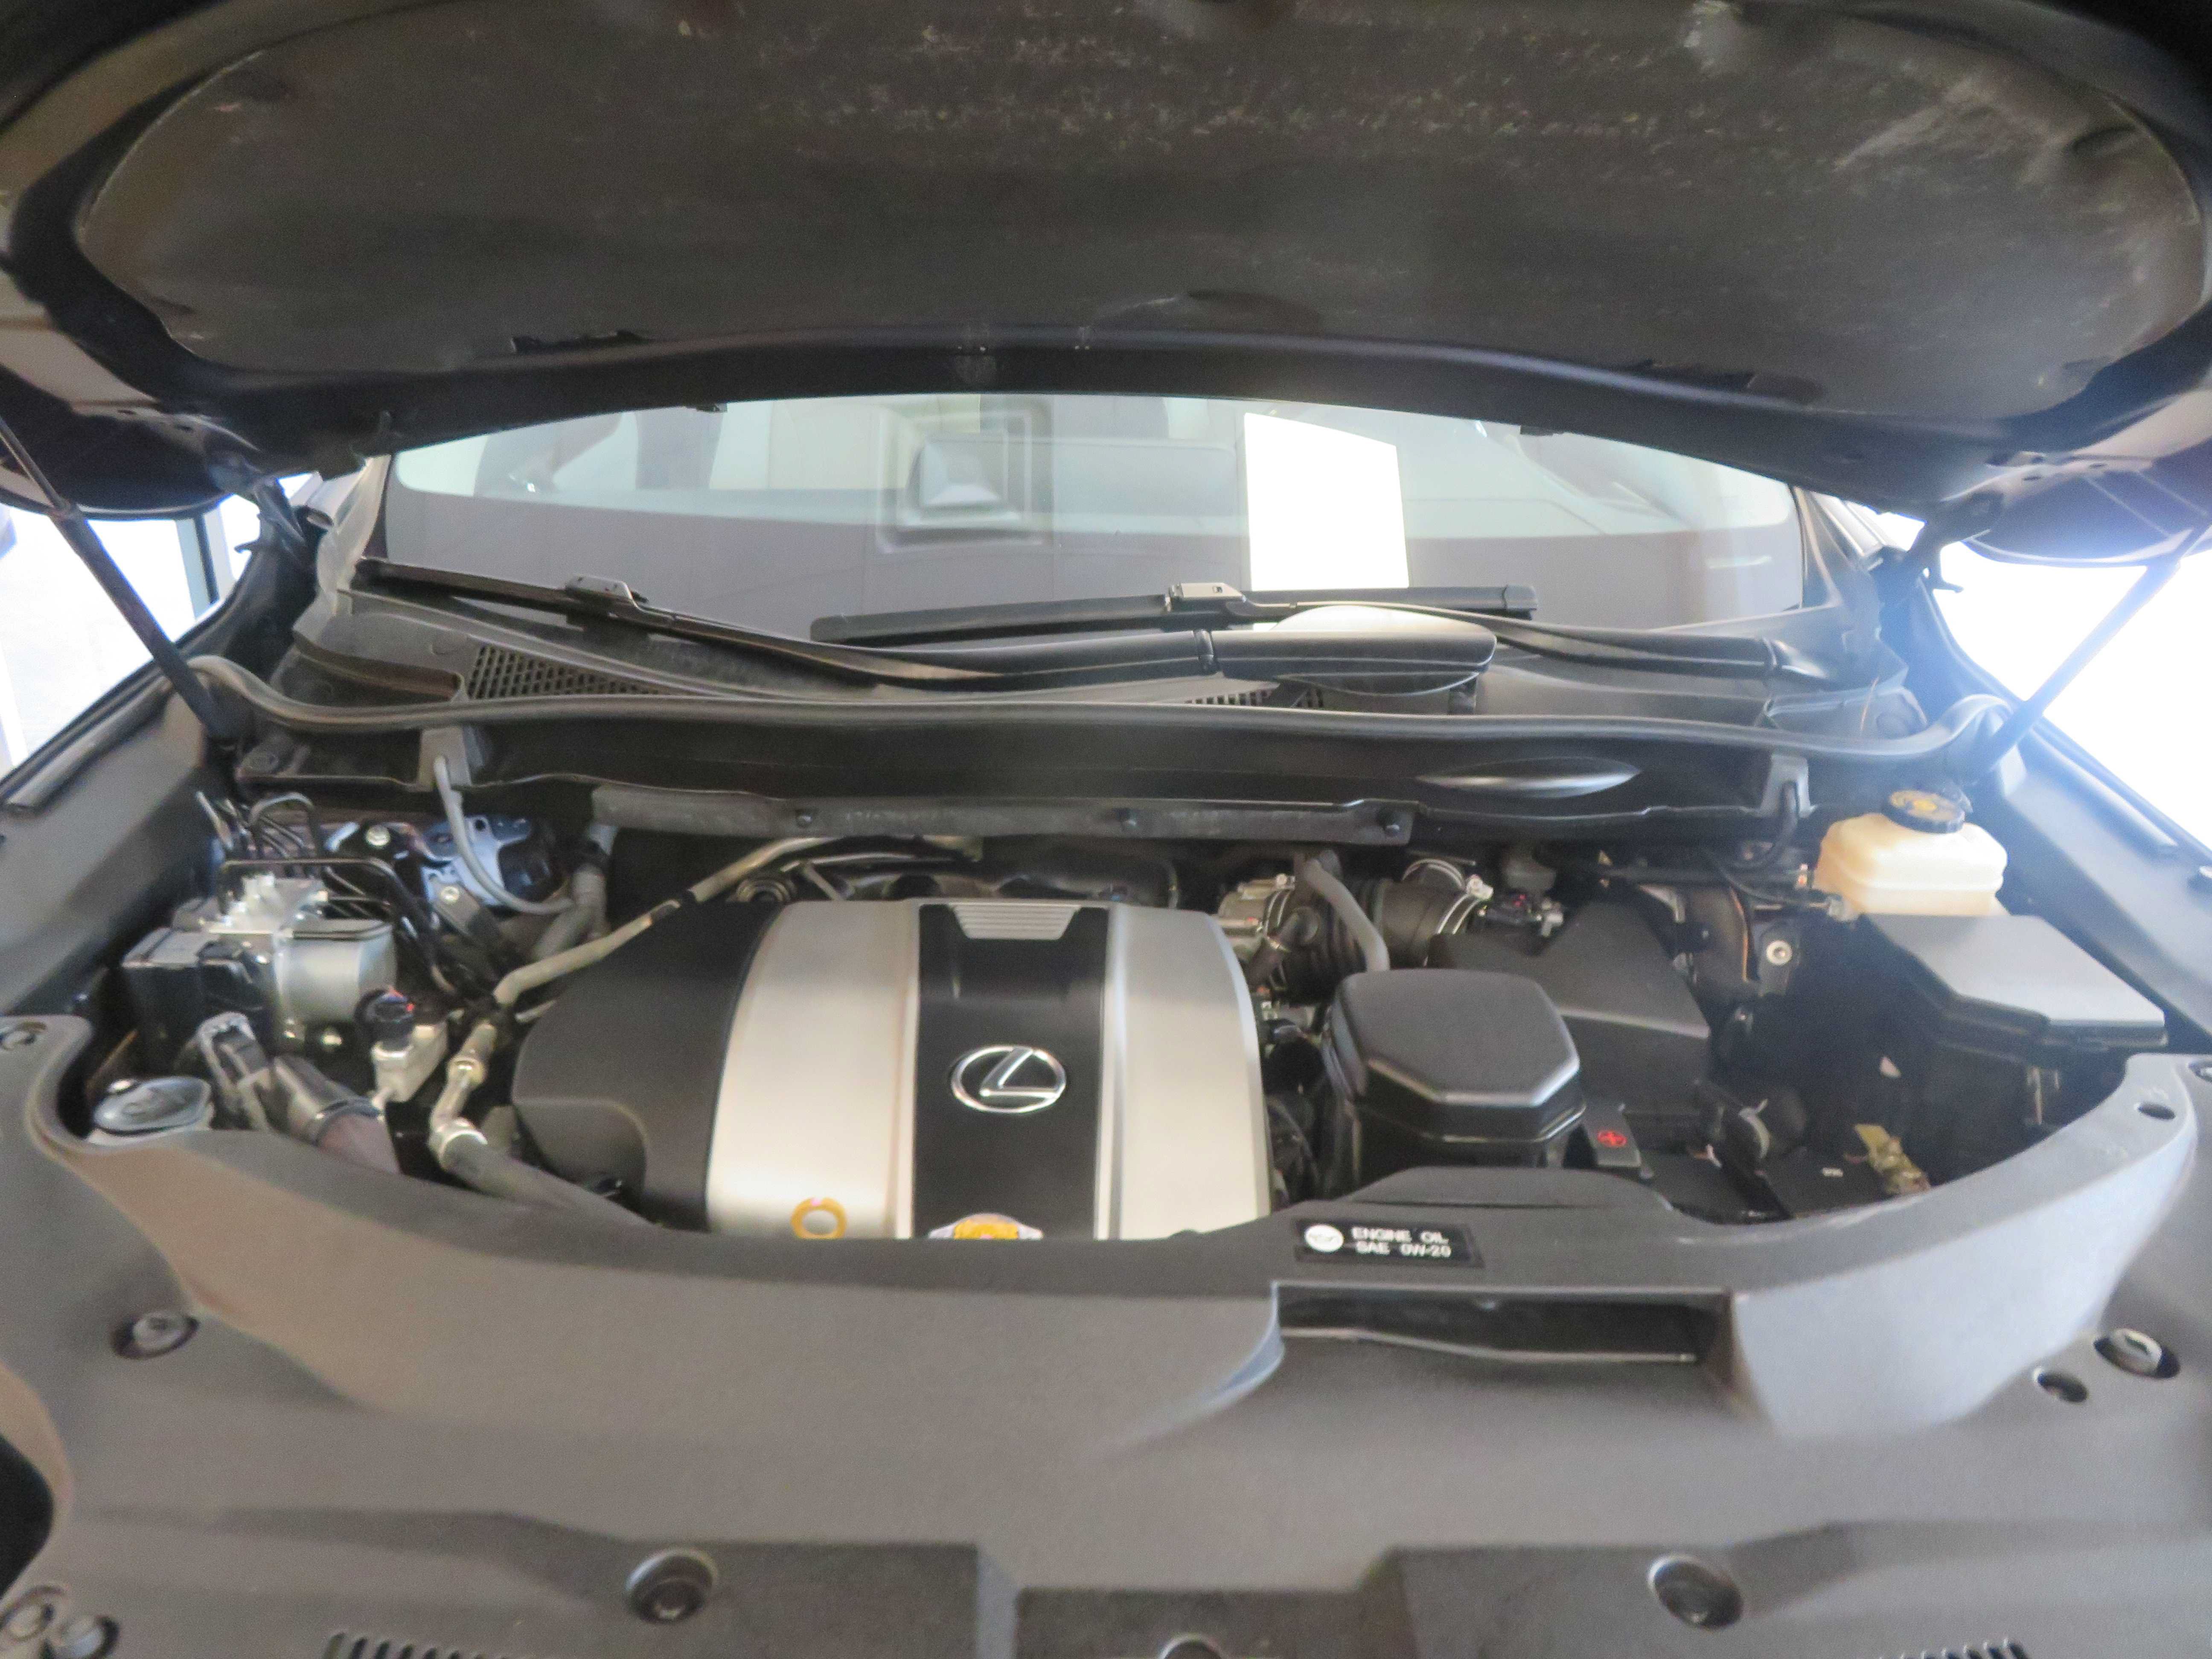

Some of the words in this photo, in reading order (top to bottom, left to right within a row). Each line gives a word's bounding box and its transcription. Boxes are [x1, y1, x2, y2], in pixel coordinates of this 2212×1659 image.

[1351, 1227, 1412, 1243] ENGINE
[1420, 1230, 1449, 1244] OIL
[1355, 1241, 1391, 1255] SAE
